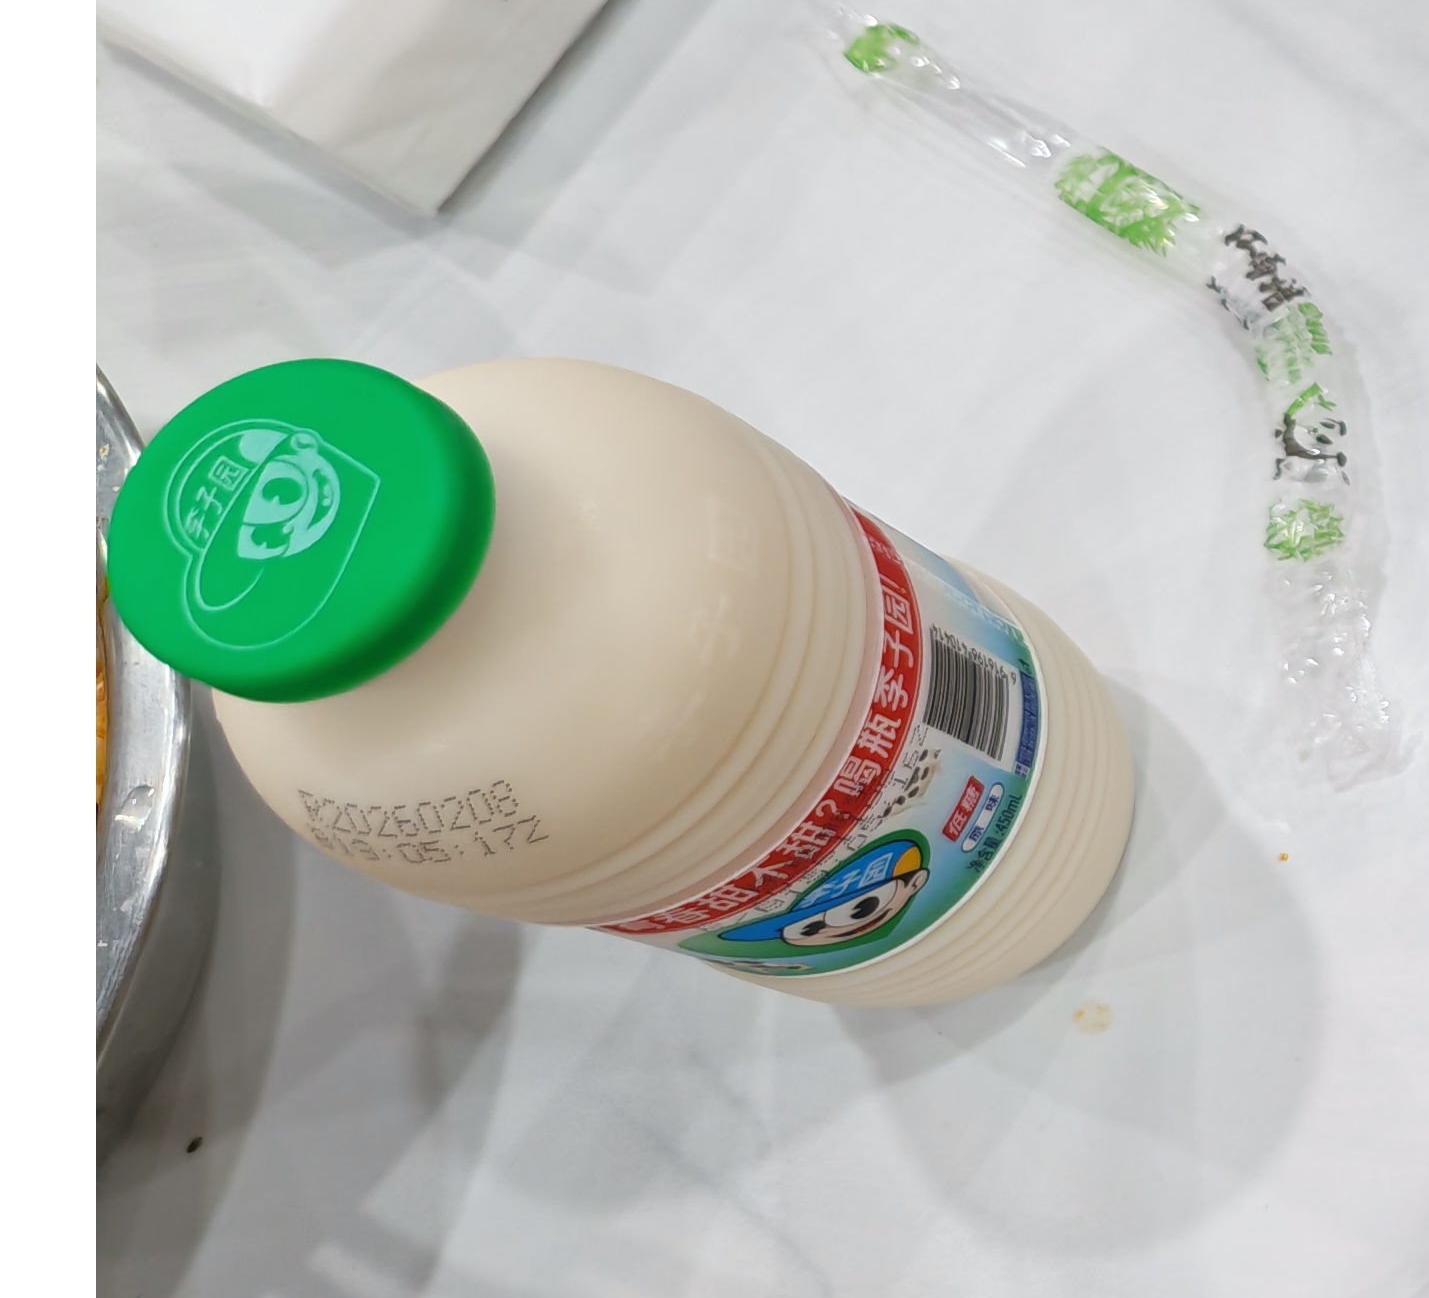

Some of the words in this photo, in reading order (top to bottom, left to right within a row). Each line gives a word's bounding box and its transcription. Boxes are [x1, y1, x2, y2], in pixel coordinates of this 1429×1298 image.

[185, 456, 250, 539] 李子园
[949, 784, 981, 836] 低糖
